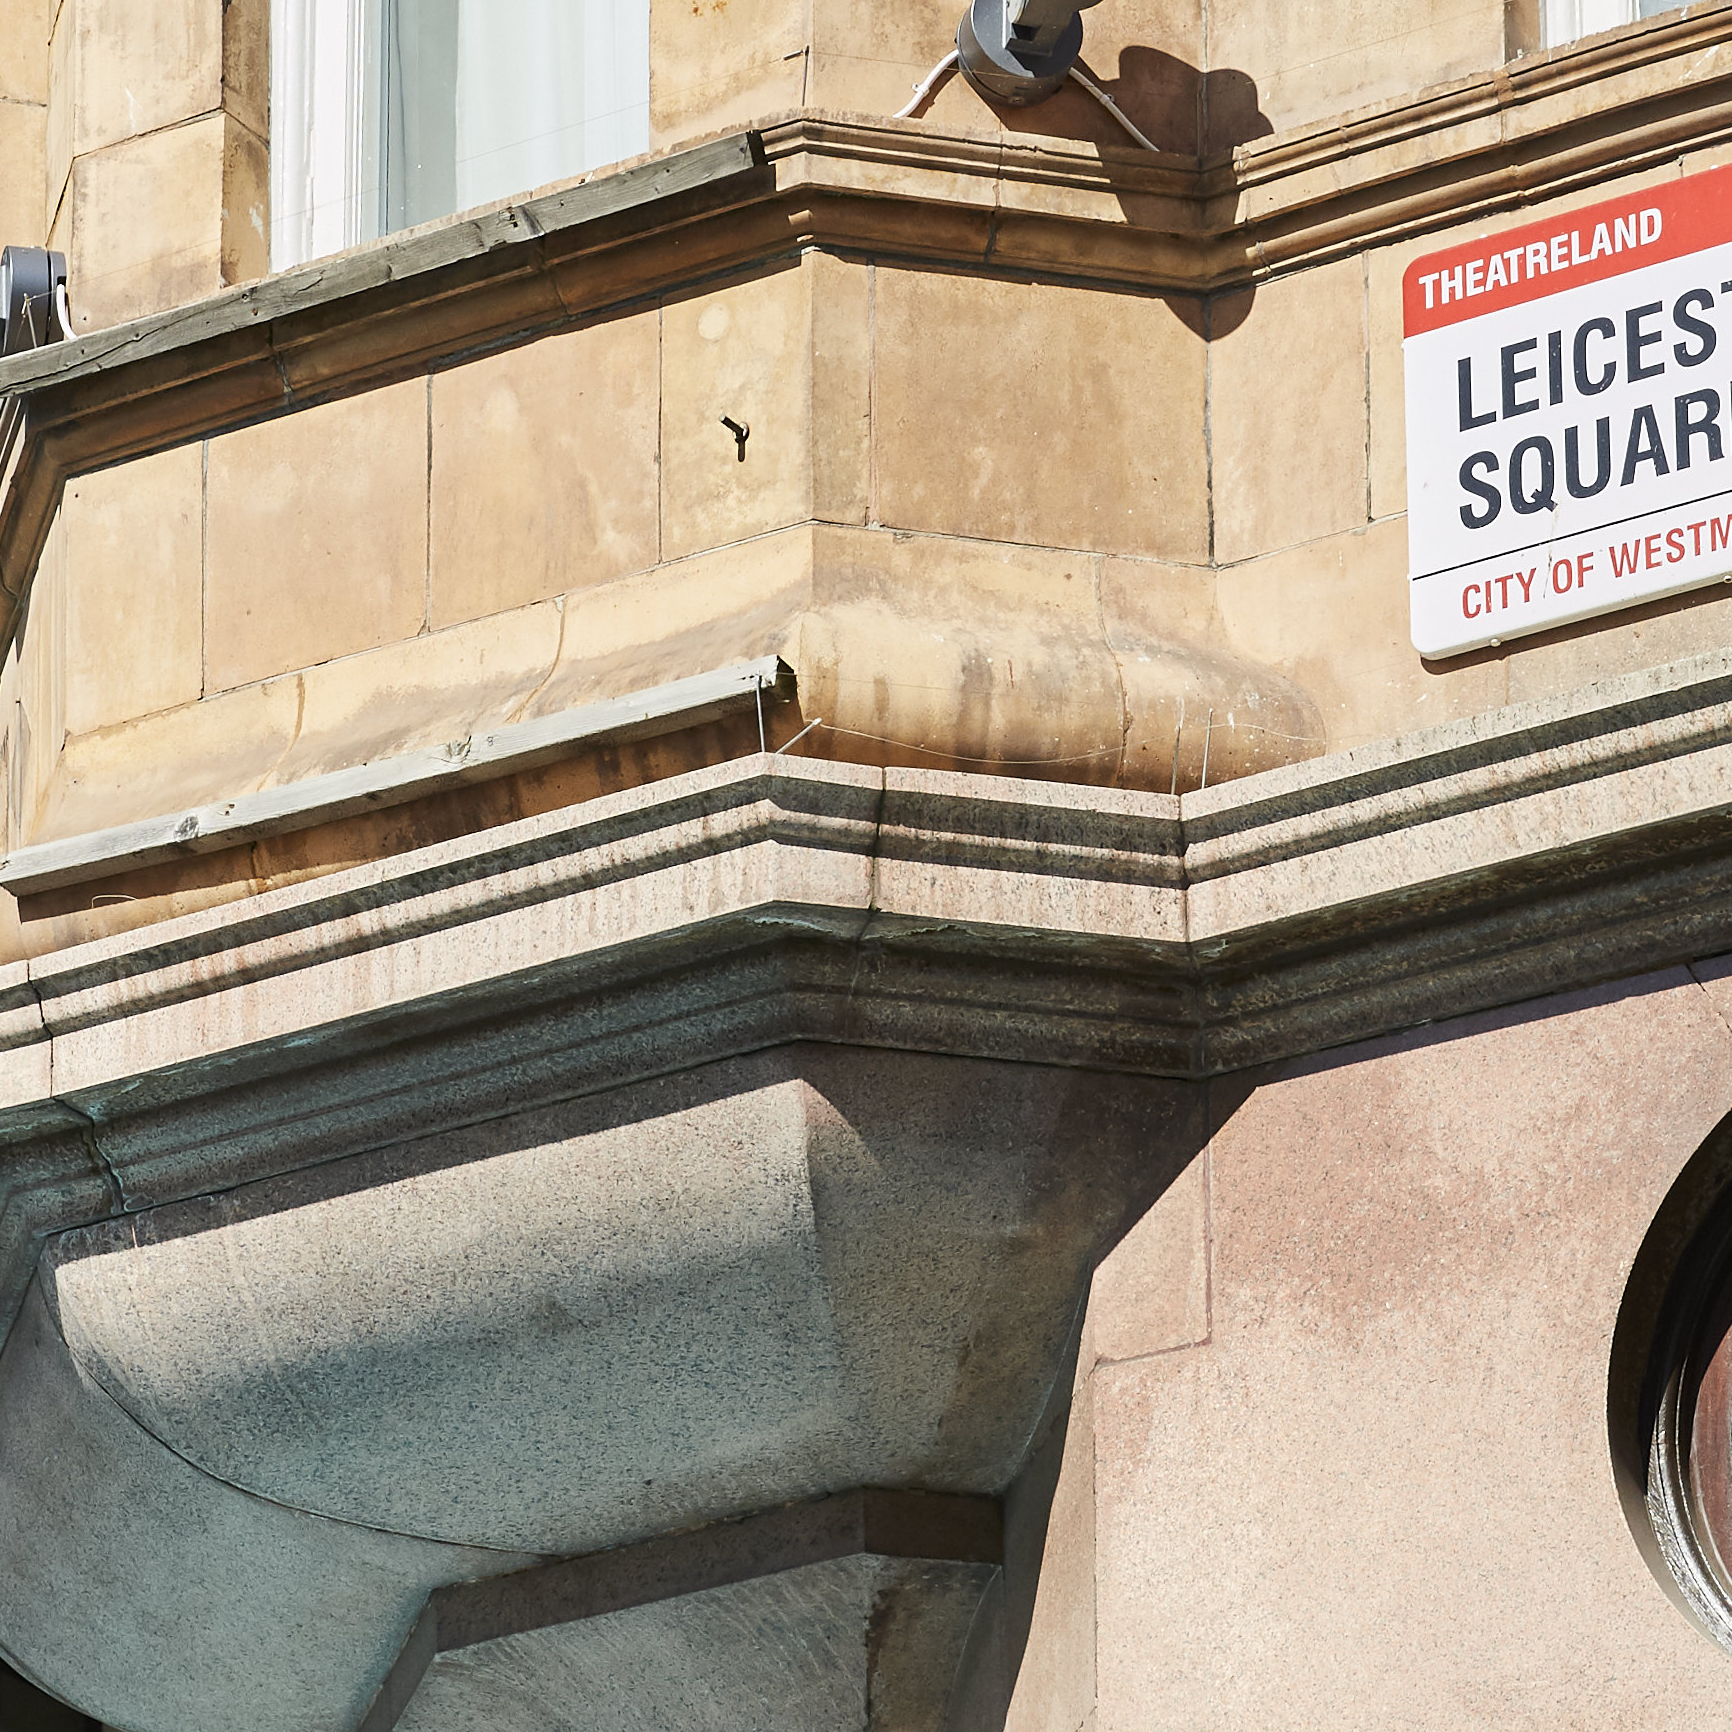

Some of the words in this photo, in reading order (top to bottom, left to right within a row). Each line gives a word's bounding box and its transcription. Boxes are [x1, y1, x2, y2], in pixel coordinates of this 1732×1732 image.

[1419, 207, 1663, 309] THEATRELAND
[1462, 569, 1537, 619] CITY
[1552, 553, 1595, 596] OF
